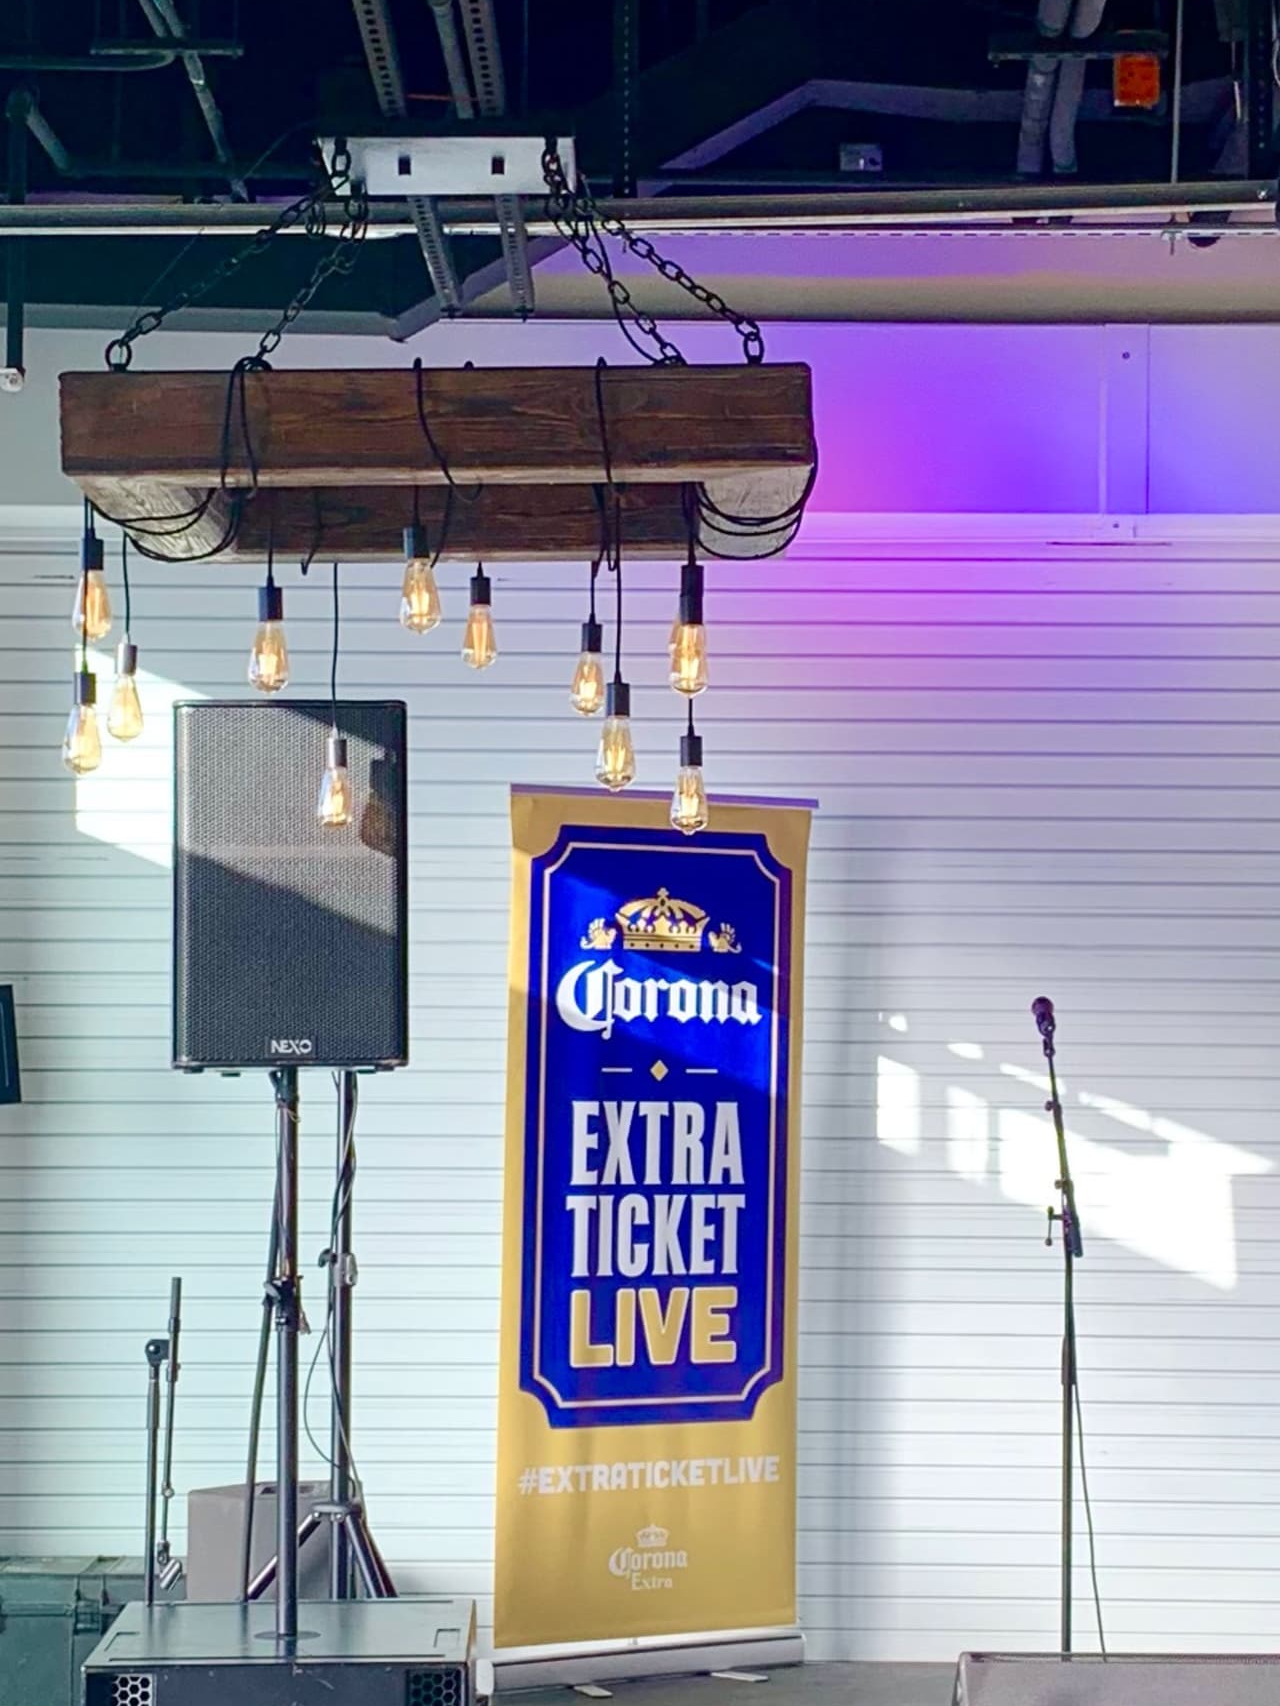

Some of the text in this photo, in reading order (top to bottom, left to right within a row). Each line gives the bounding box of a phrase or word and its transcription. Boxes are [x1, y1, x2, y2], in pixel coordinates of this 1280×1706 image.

[556, 959, 763, 1040] Corona
[270, 1039, 313, 1055] NEXO
[570, 1100, 745, 1185] EXTRA
[565, 1193, 746, 1278] TICKET
[569, 1286, 739, 1368] LIVE
[517, 1455, 780, 1495] #EXTRATICKETLIVE
[608, 1546, 688, 1580] Corona
[631, 1572, 672, 1590] Extra
